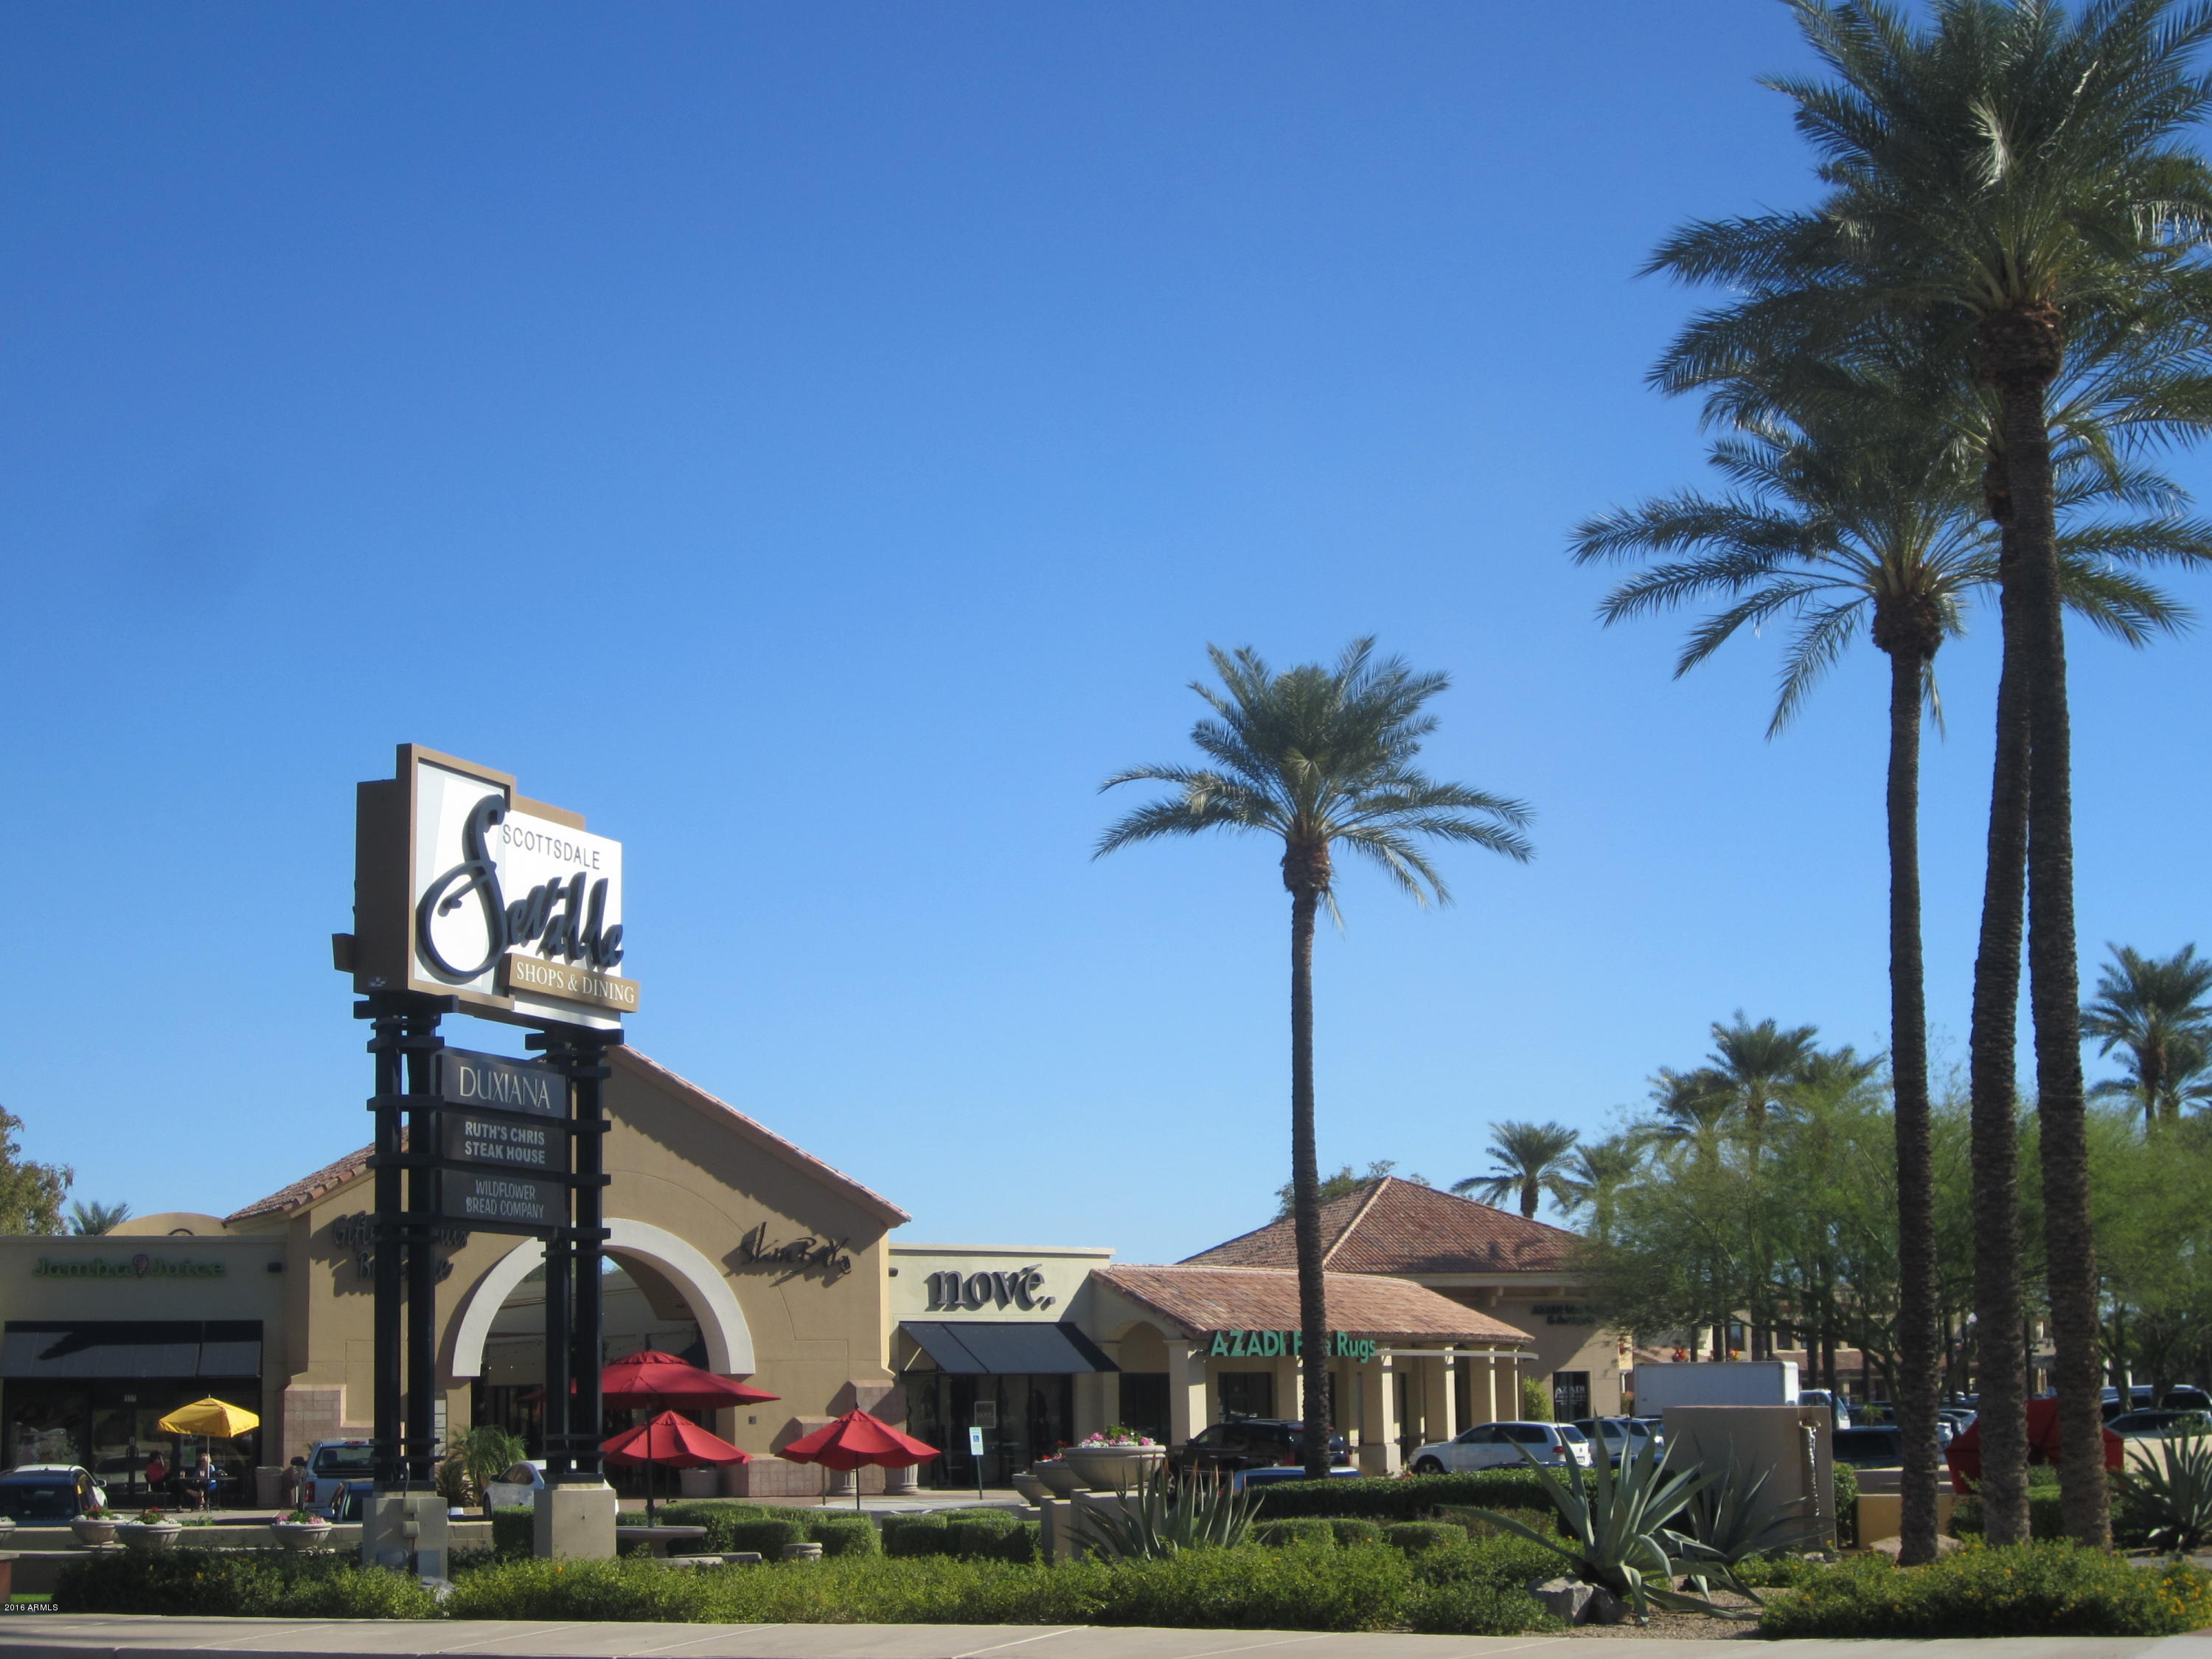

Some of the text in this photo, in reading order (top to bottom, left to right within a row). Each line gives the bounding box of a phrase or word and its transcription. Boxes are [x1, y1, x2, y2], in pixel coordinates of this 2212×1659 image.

[502, 824, 601, 870] SCOTTSDALE
[515, 962, 635, 1004] SHOPS & DINING
[459, 1066, 550, 1110] DUXIANA
[465, 1121, 546, 1146] RUTH'S CHRIS
[465, 1140, 546, 1164] STEAK HOUSE
[475, 1180, 536, 1200] WILDFLOWER
[466, 1197, 544, 1219] BREAD COMPANY
[33, 1256, 226, 1277] Jamba Juice
[1211, 1330, 1286, 1357] AZADI
[1337, 1331, 1377, 1363] Rugs
